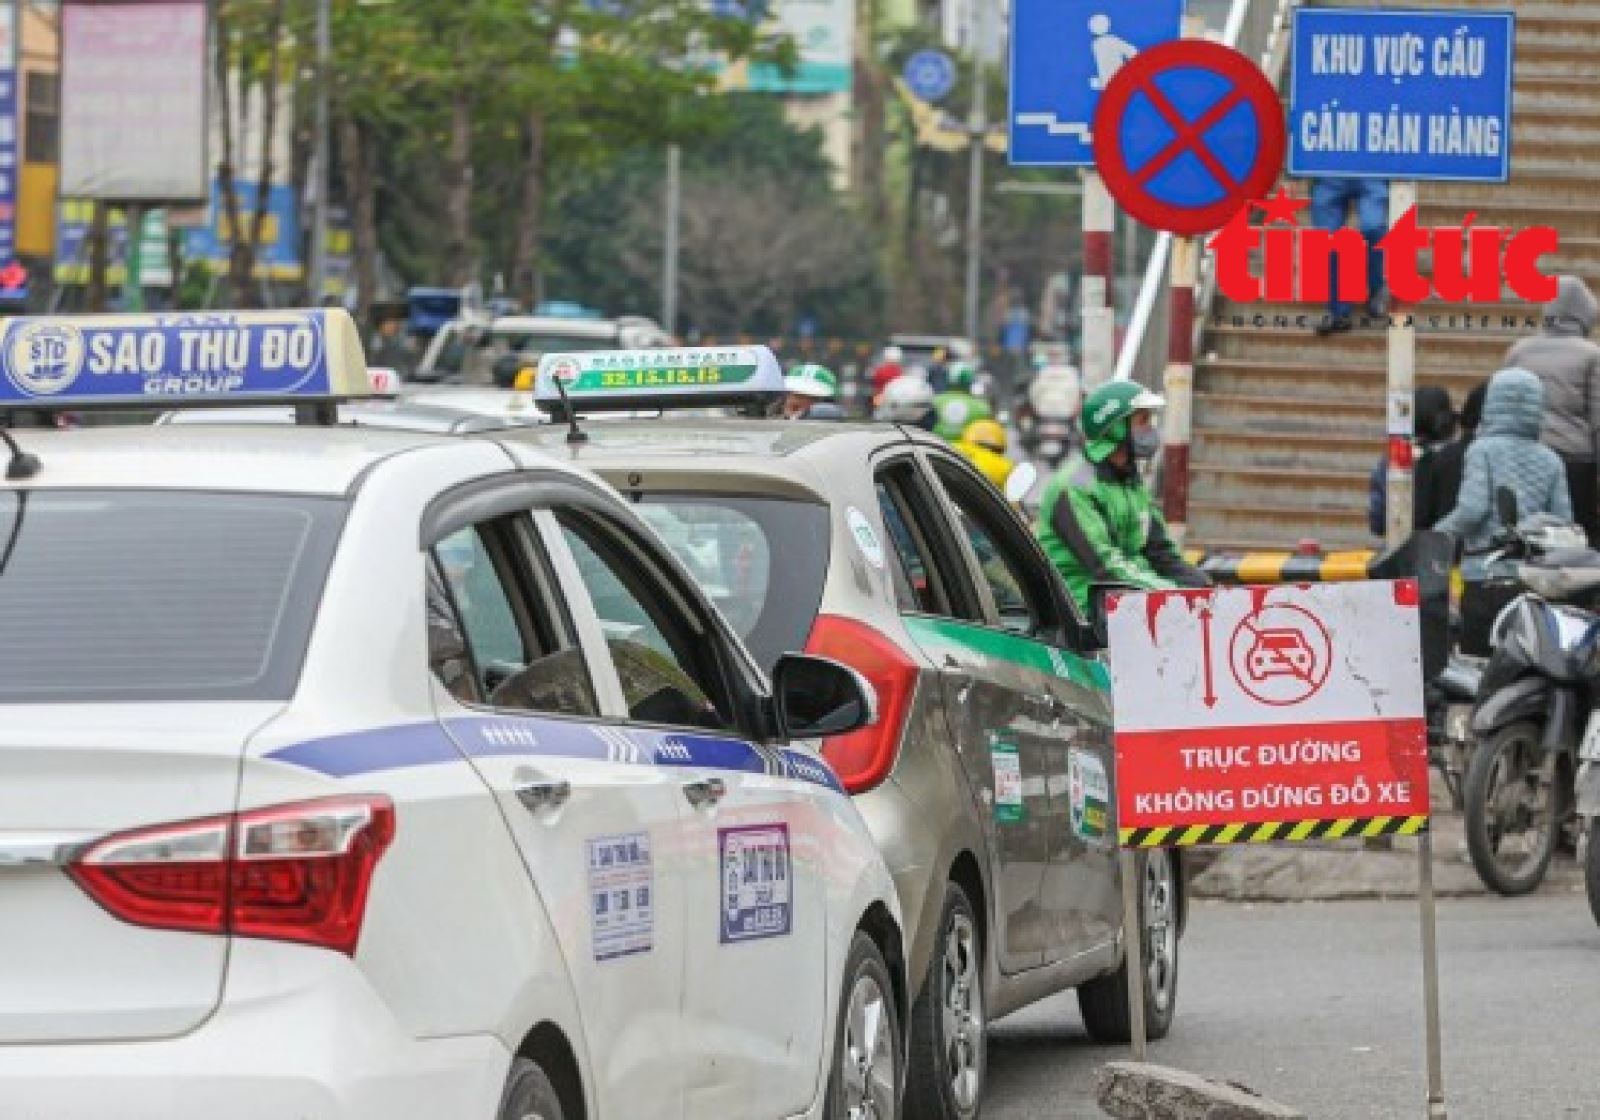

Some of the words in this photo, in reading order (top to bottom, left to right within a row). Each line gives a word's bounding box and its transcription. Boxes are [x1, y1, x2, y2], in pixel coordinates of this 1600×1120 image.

[1312, 33, 1366, 75] KHU
[1373, 31, 1425, 84] VỰC
[1301, 98, 1361, 152] CẤM
[1366, 103, 1422, 153] BÁN
[1428, 104, 1502, 157] HÀNG
[31, 337, 66, 360] STD
[89, 331, 166, 375] SAO
[144, 376, 243, 394] GROUP
[1180, 745, 1250, 774] TRỤC
[1258, 738, 1361, 766] ĐƯỜNG
[1135, 786, 1234, 814] KHÔNG
[1242, 783, 1323, 809] DỪNG
[1330, 774, 1370, 805] ĐỖ
[1377, 781, 1411, 804] XE
